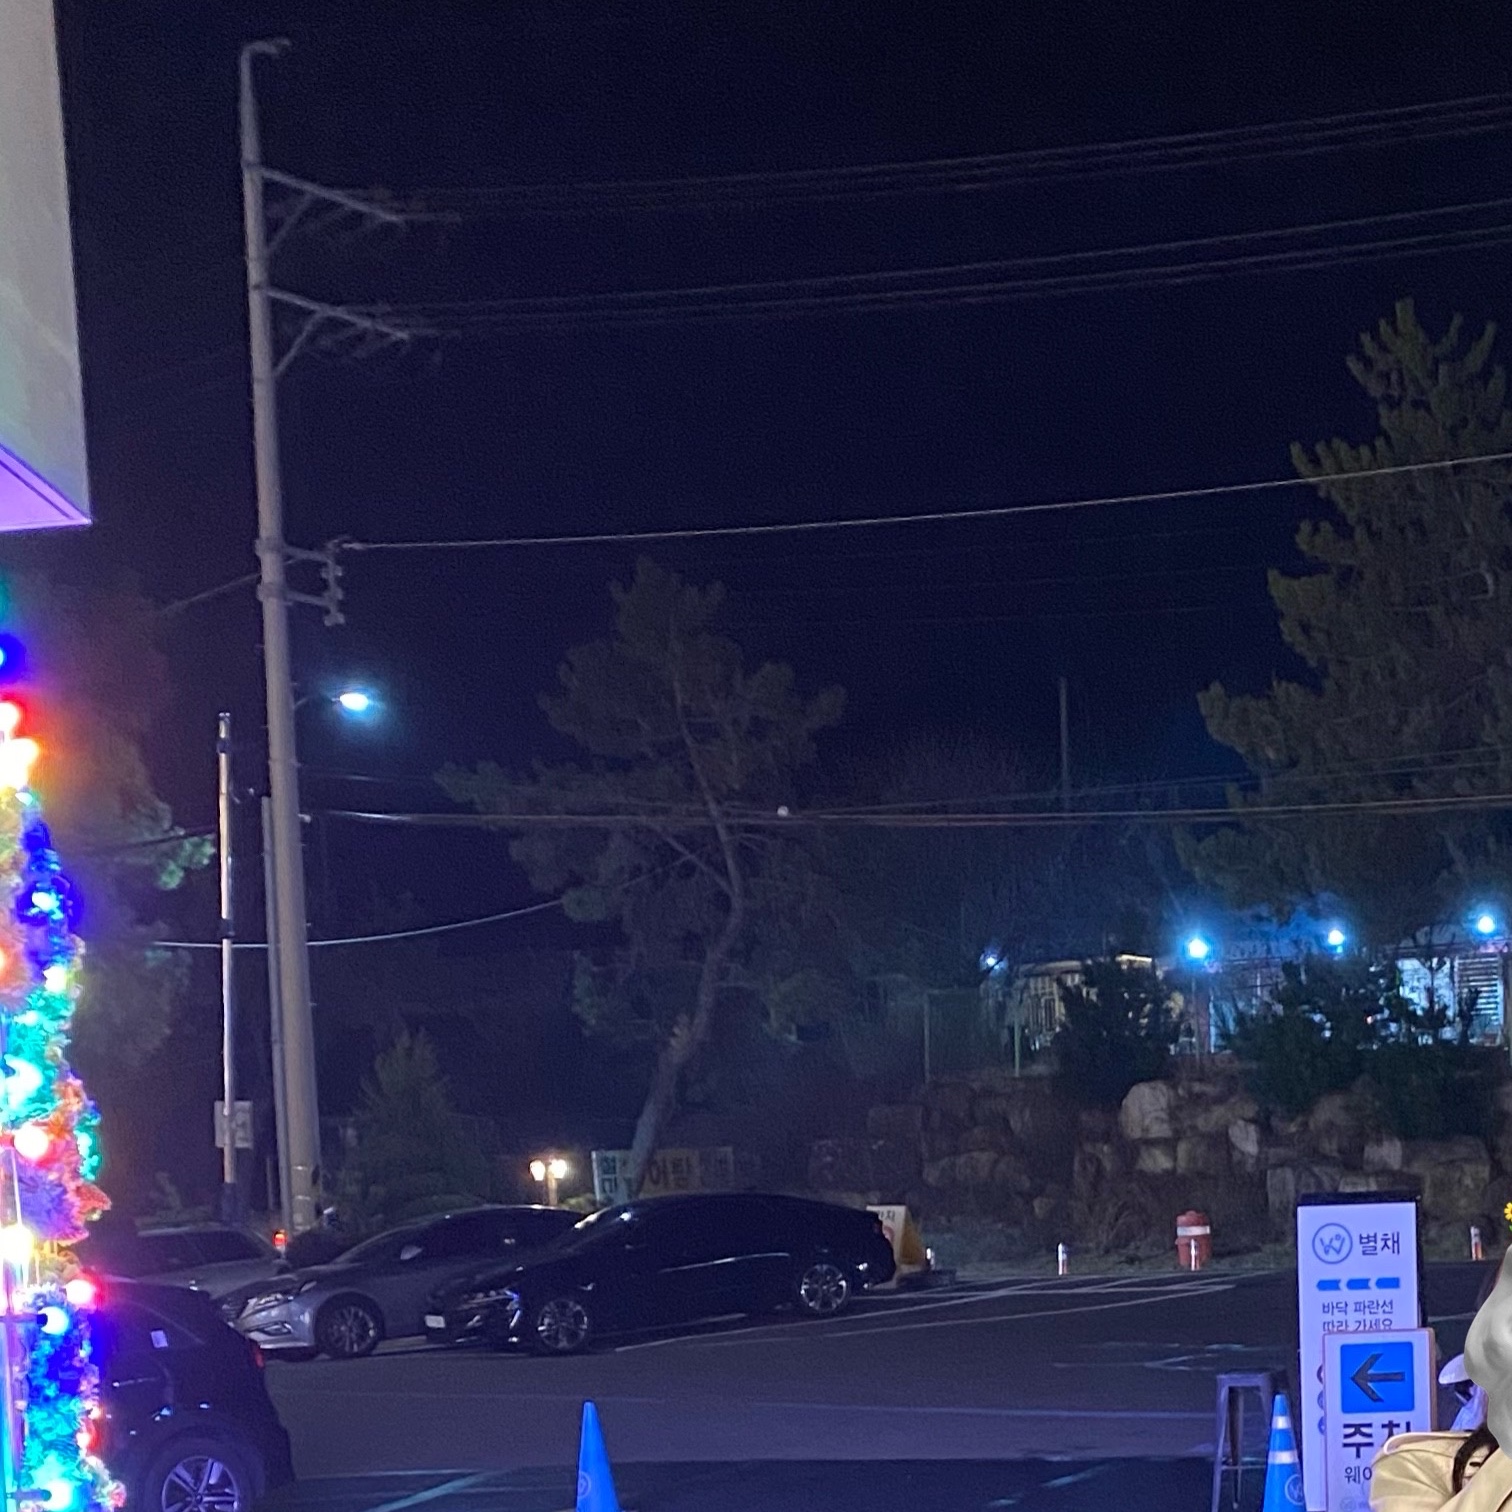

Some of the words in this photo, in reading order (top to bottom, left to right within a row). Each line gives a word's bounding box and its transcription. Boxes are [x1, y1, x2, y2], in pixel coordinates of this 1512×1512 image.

[1358, 1231, 1401, 1256] 별채
[1322, 1301, 1348, 1316] 바닥
[1353, 1299, 1394, 1315] 파란선
